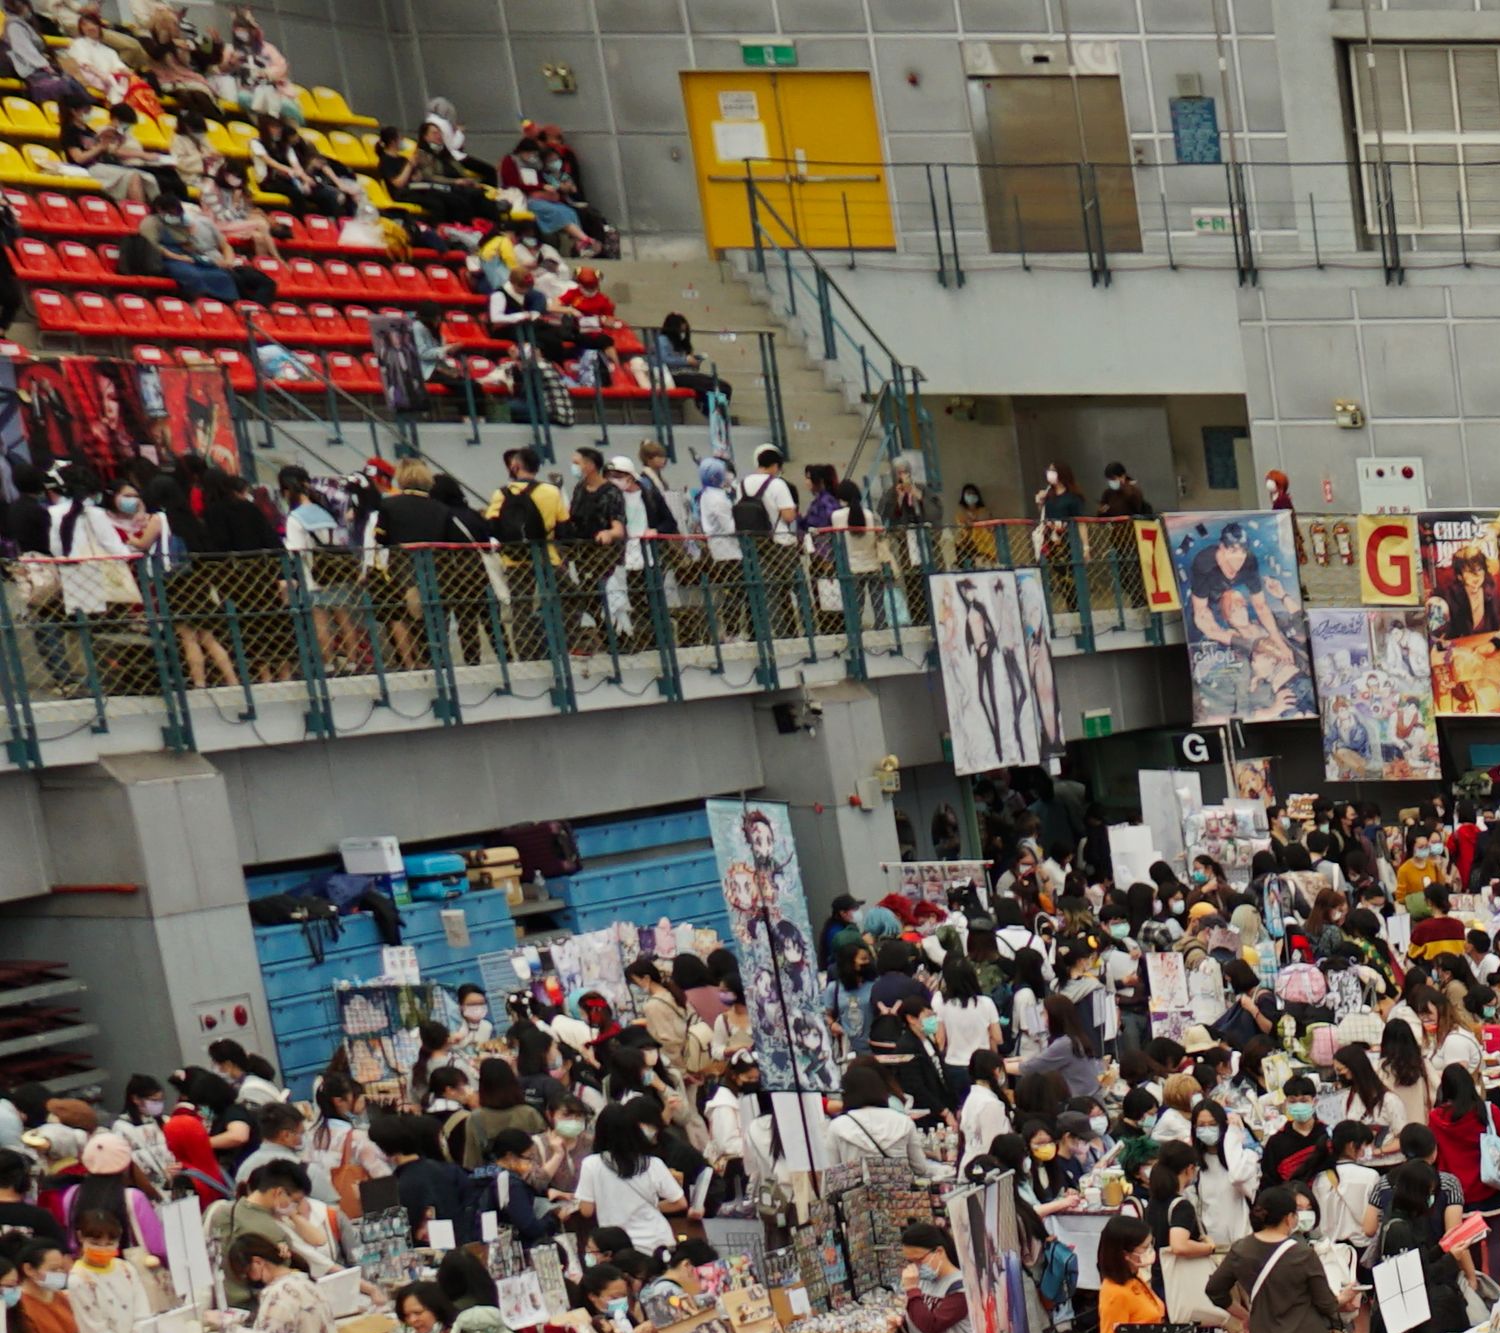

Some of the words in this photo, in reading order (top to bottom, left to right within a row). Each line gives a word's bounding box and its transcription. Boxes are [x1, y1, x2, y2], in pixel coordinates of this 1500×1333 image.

[1141, 528, 1173, 604] I
[1366, 524, 1412, 597] G
[1182, 733, 1210, 763] G
